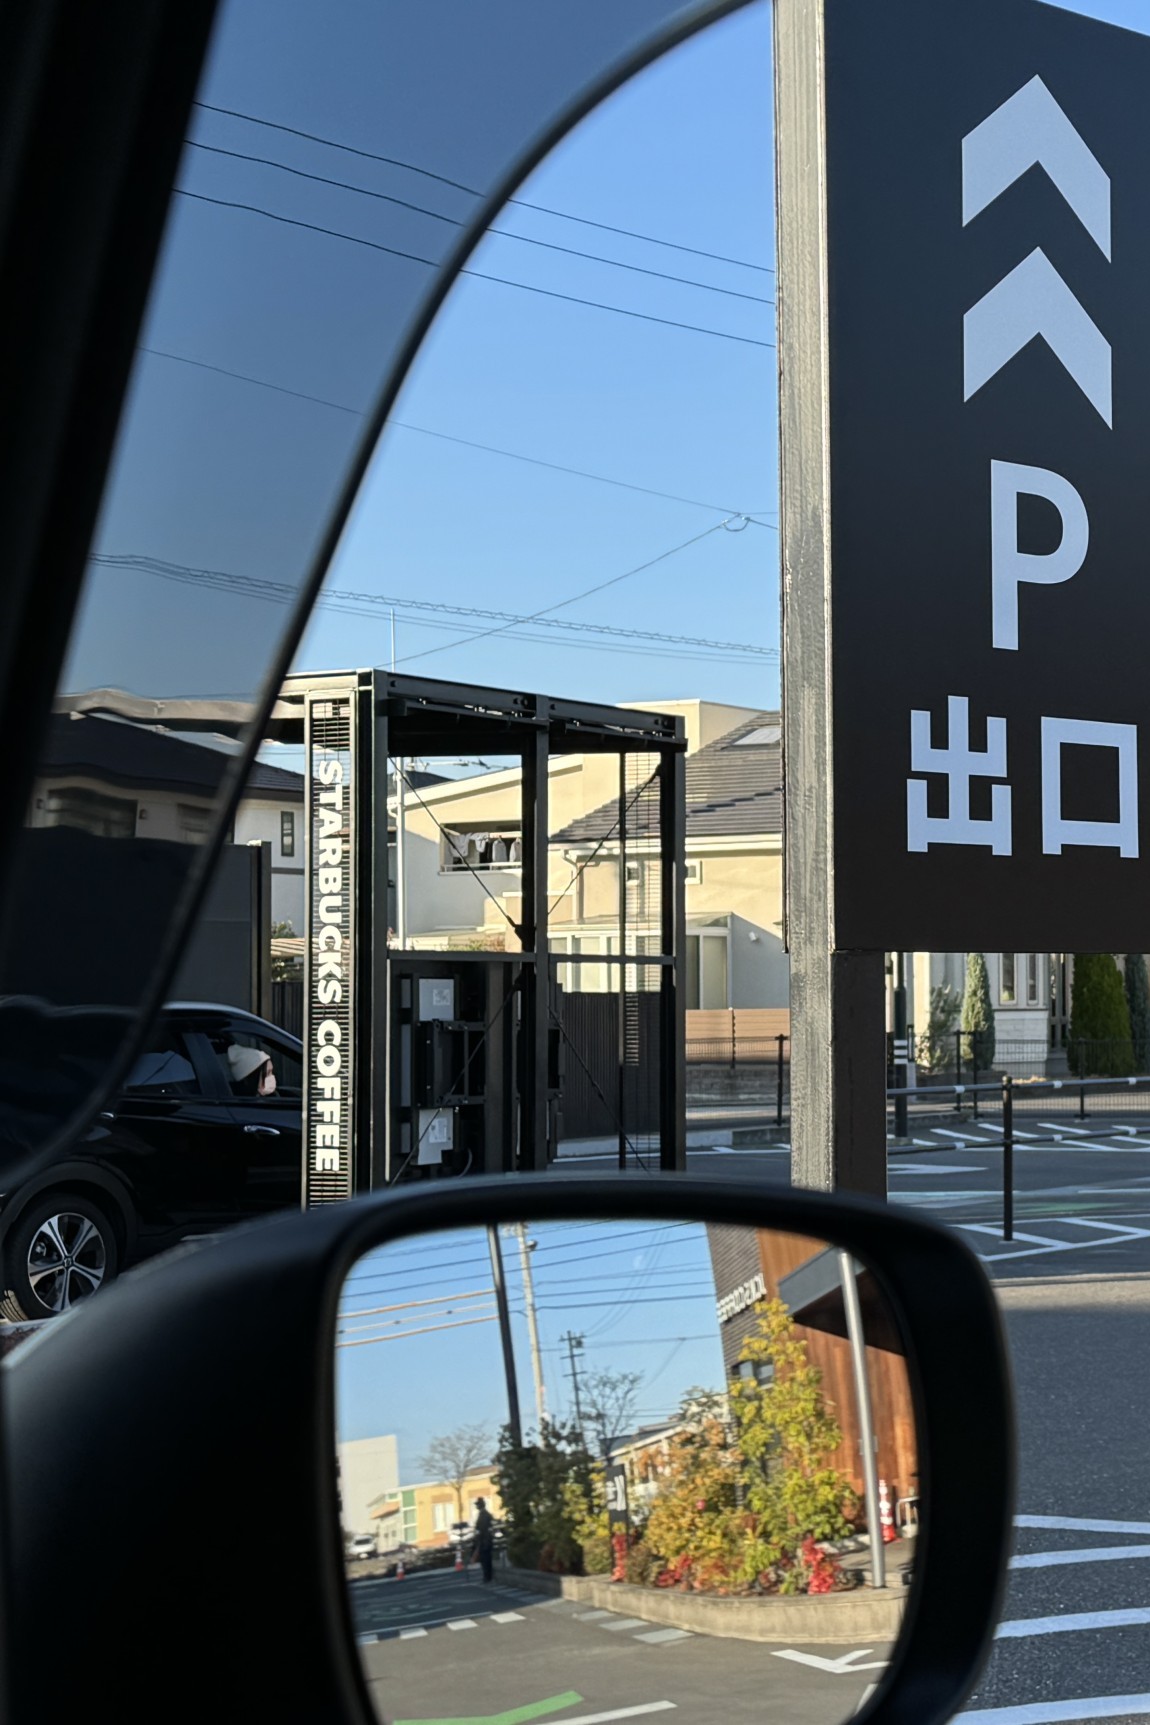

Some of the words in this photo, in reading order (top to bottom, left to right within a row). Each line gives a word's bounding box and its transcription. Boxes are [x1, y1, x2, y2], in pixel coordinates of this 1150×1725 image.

[991, 459, 1089, 651] P
[907, 696, 1139, 858] 出口
[318, 758, 343, 1006] STARBUCKS
[314, 1018, 342, 1173] COFFEE
